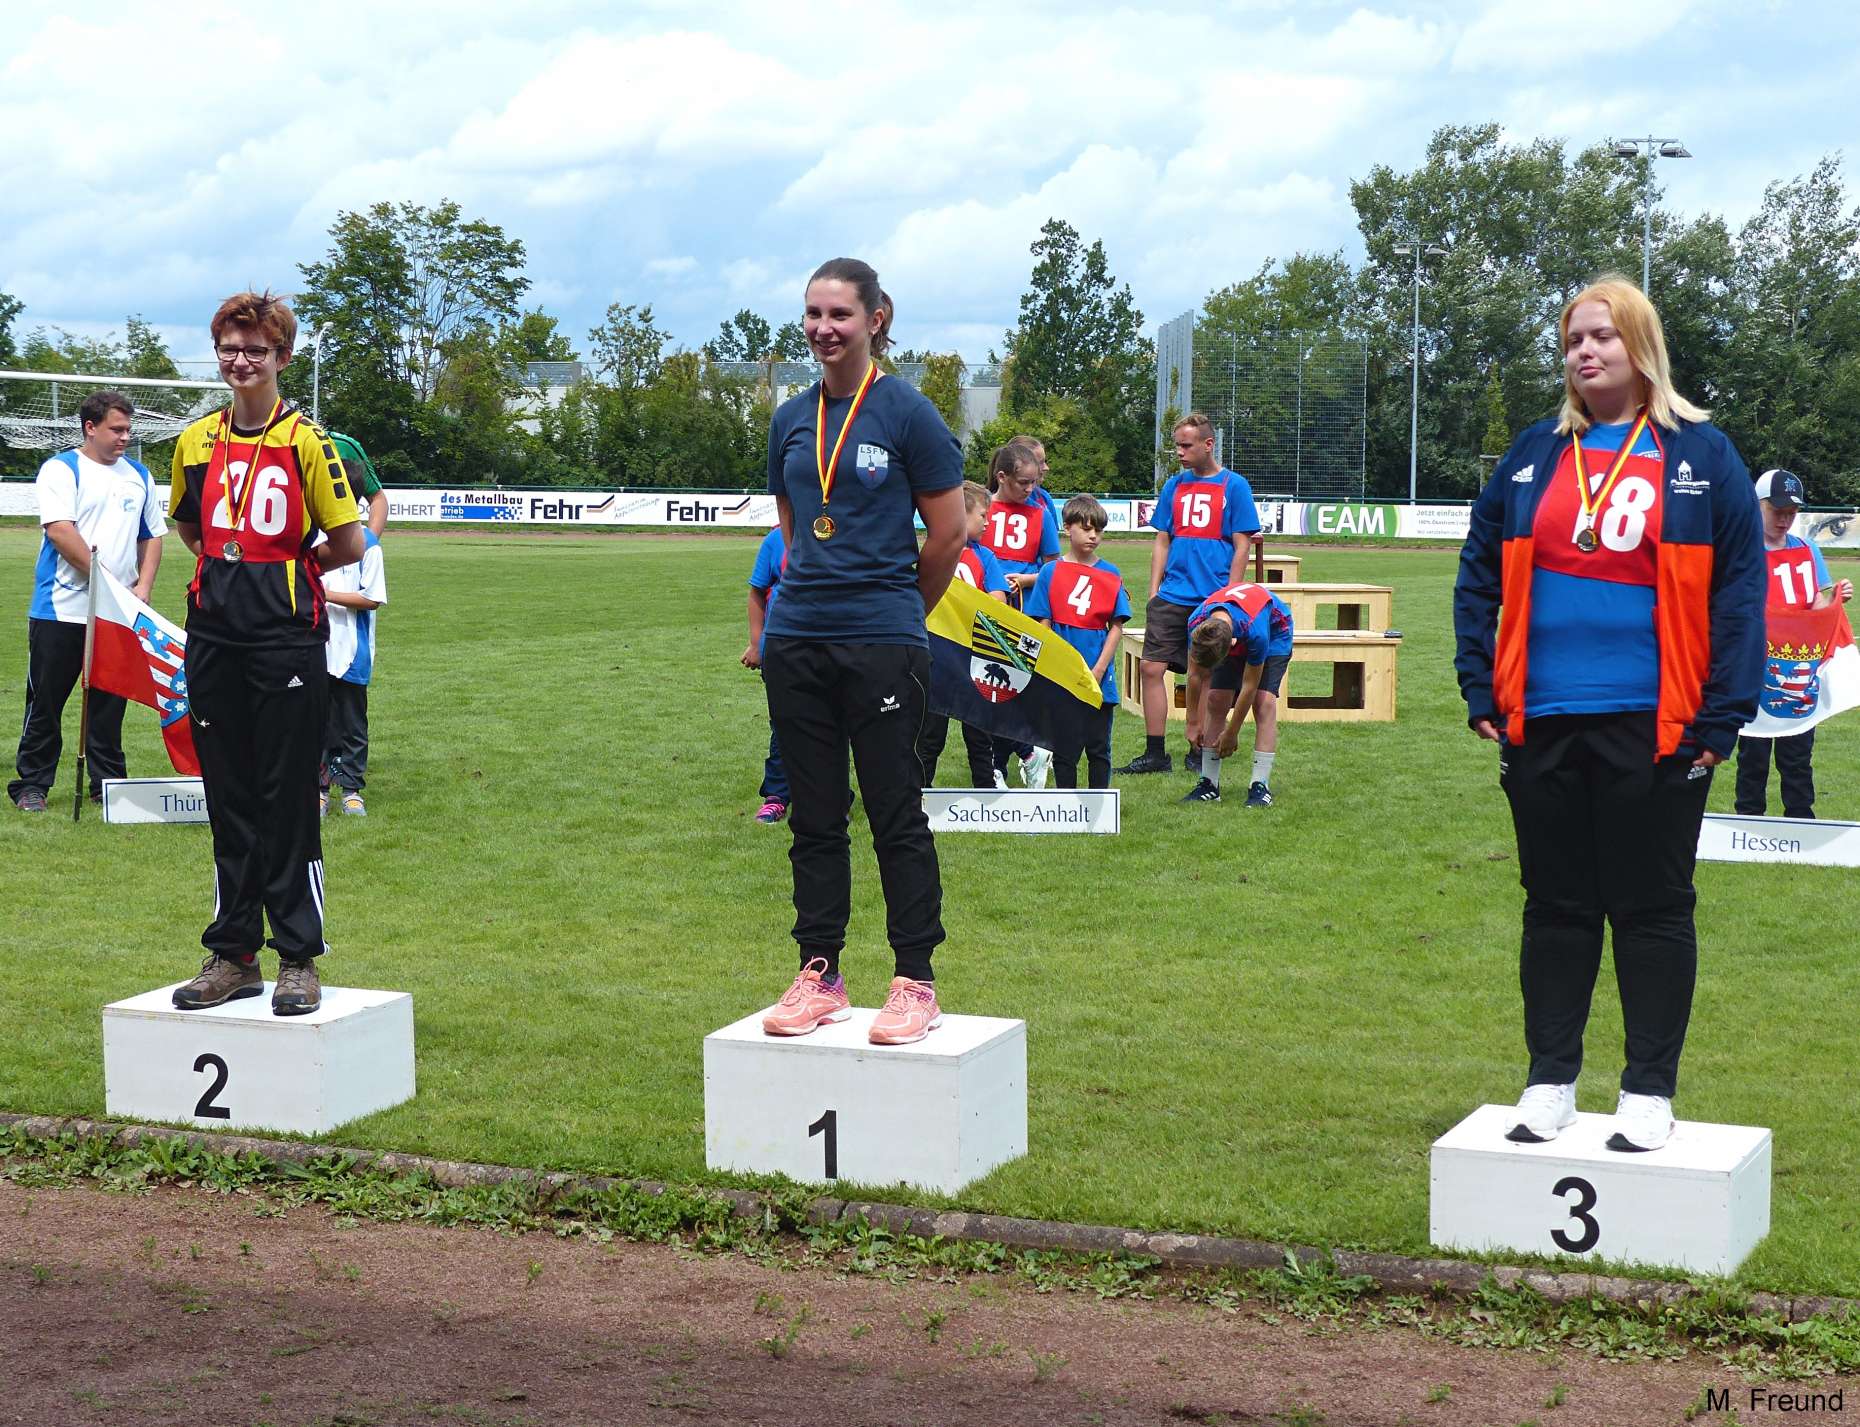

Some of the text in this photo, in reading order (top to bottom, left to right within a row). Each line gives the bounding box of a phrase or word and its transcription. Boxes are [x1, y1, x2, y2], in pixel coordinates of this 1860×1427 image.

[860, 446, 886, 455] LSFV
[211, 460, 289, 536] 26
[441, 493, 523, 505] des Metallbau
[530, 498, 583, 520] Fehr
[666, 500, 720, 522] Fehr
[1181, 493, 1212, 528] 15
[1571, 473, 1656, 552] 18
[991, 511, 1028, 550] 13
[1317, 505, 1385, 535] EAM
[1067, 575, 1093, 616] 4
[1773, 560, 1815, 604] 11
[947, 804, 1090, 823] Sachsen-Anhalt
[1732, 831, 1800, 853] Hessen
[193, 1053, 231, 1120] 2
[808, 1109, 838, 1180] 1
[1549, 1176, 1600, 1254] 3
